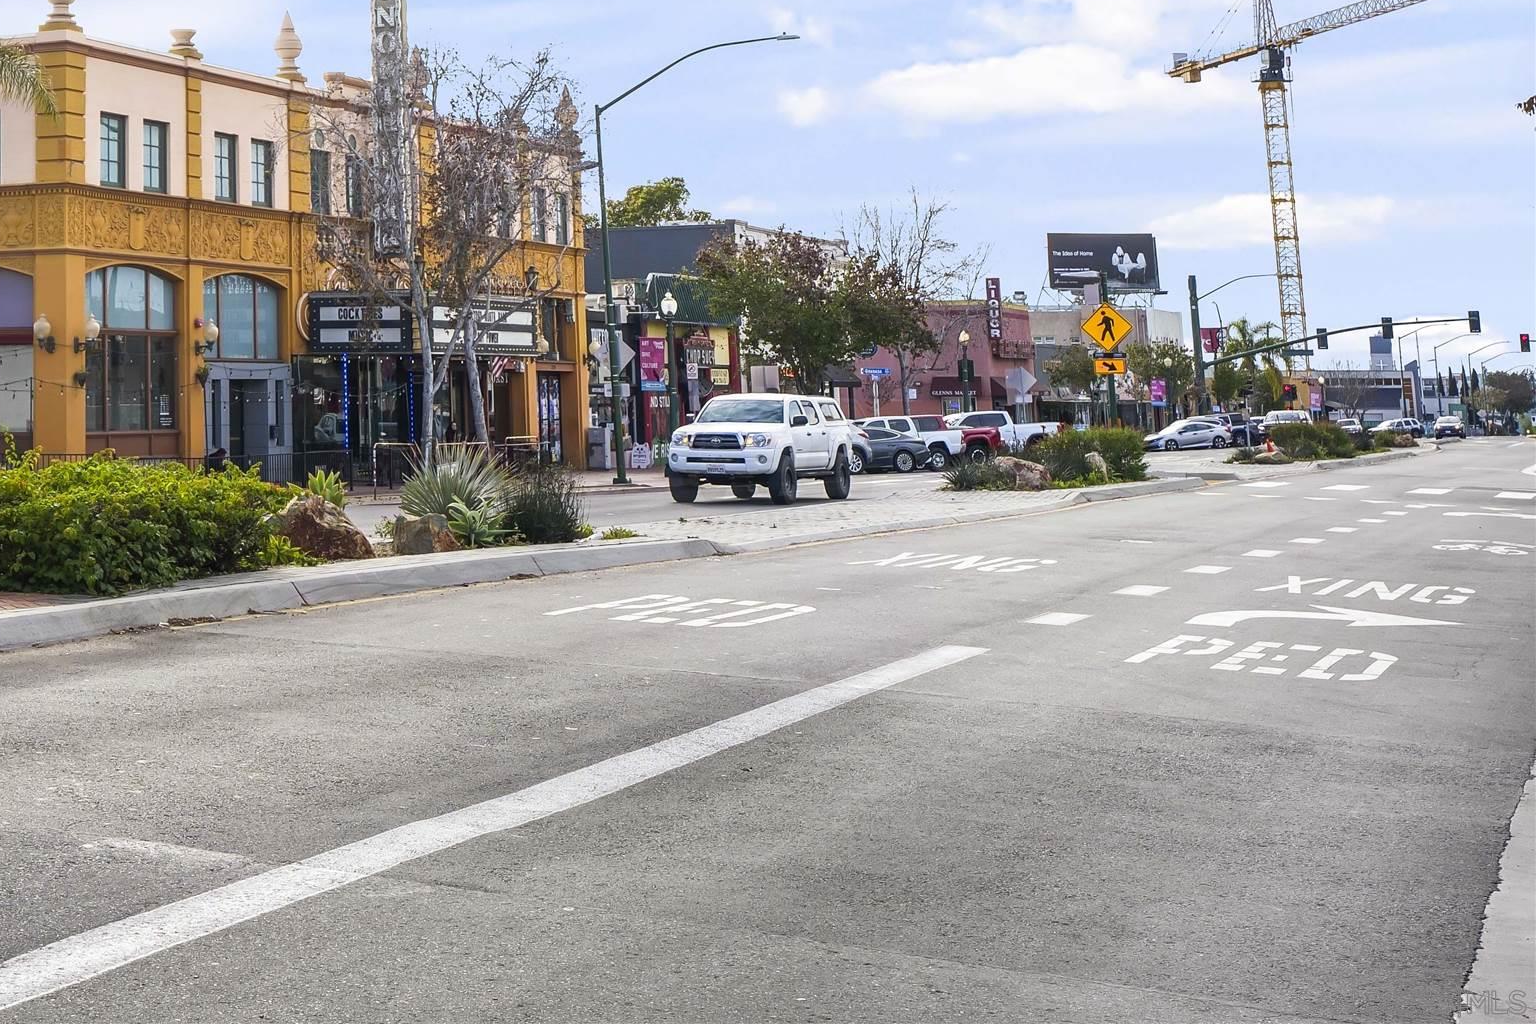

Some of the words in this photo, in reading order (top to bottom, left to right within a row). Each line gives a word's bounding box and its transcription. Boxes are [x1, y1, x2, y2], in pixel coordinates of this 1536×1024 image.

[338, 308, 383, 319] COCKTS
[987, 280, 1001, 338] LIQUOR
[1253, 575, 1476, 605] XING
[542, 594, 817, 629] PED
[1123, 634, 1399, 681] PED
